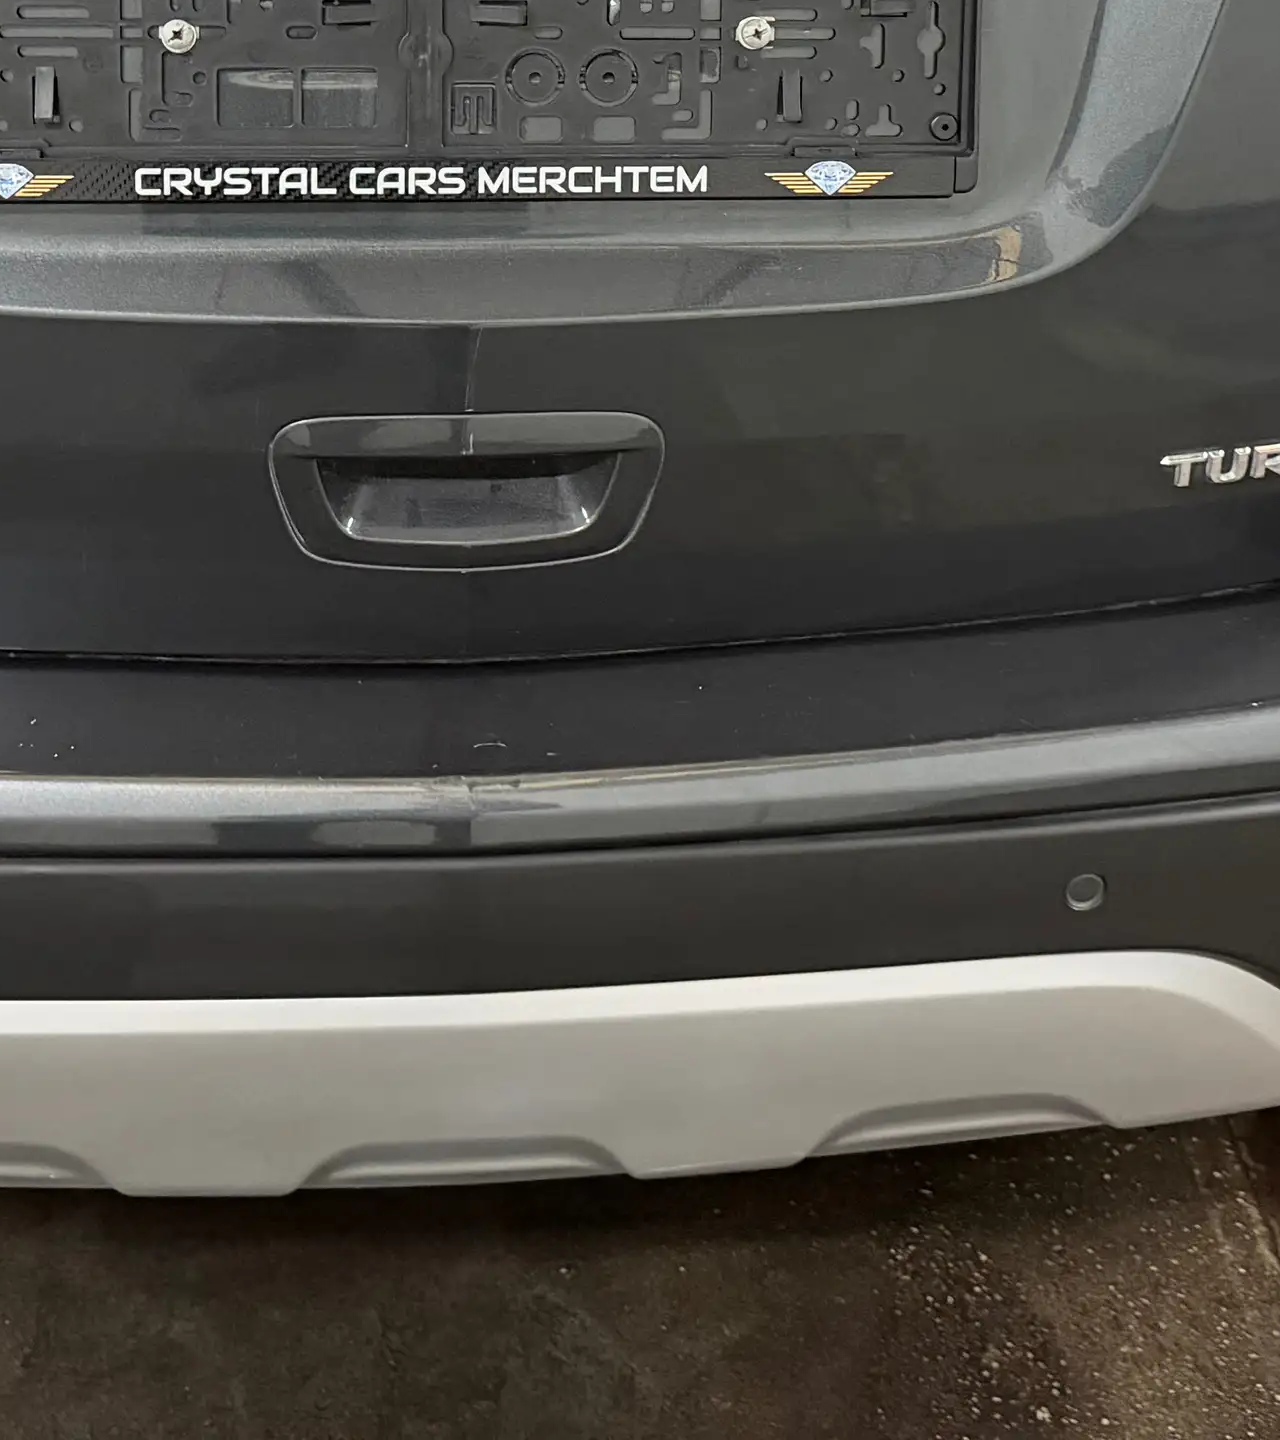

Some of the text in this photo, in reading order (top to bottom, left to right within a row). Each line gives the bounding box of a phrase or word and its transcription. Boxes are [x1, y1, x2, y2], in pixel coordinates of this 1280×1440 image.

[133, 164, 708, 196] CRYSTAL CARS MERCHTEM
